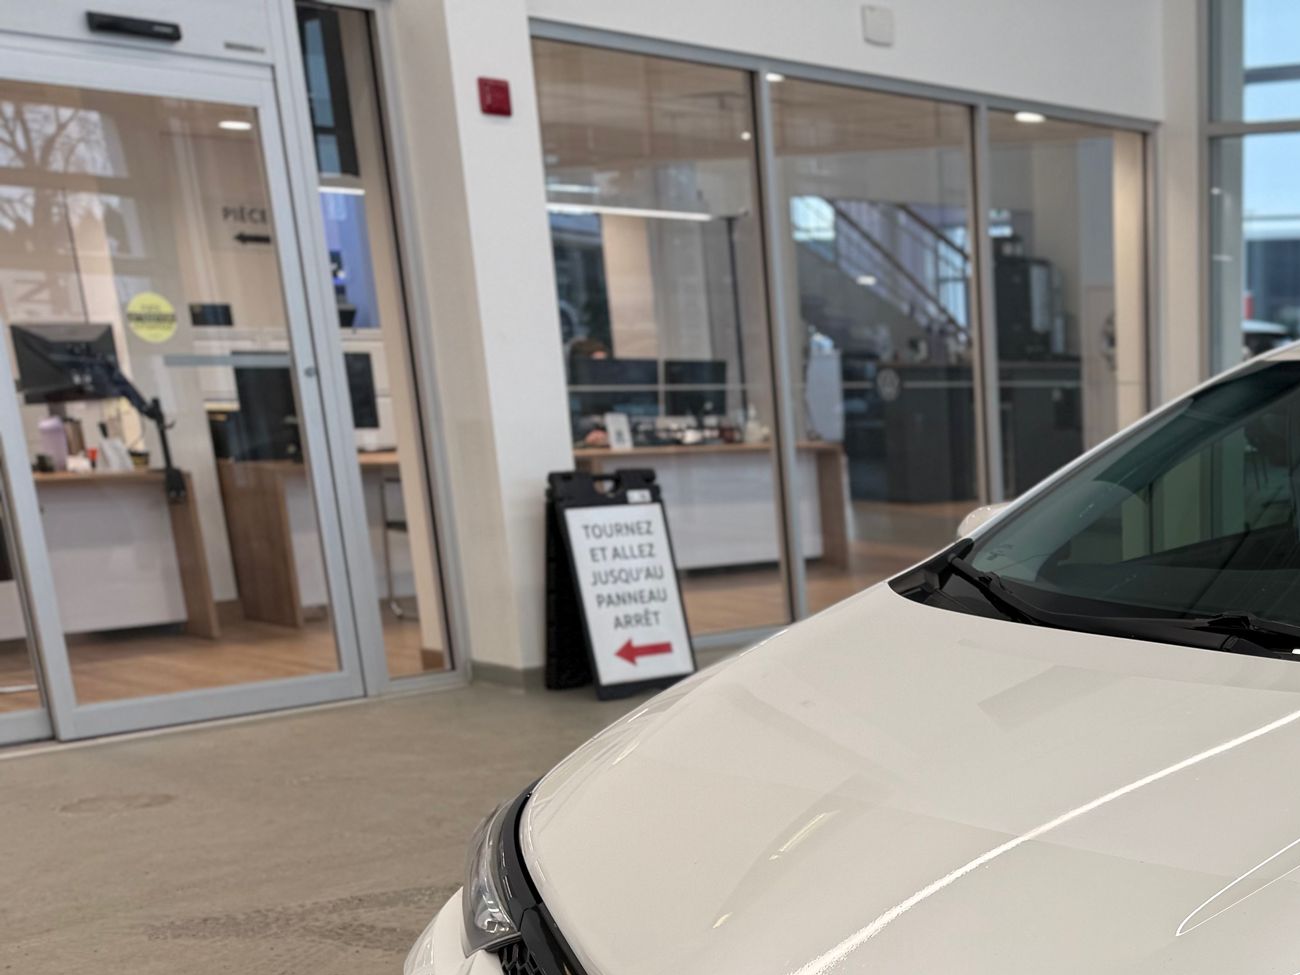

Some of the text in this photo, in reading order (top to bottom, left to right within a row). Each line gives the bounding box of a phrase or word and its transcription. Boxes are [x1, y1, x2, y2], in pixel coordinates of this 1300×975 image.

[582, 521, 653, 539] TOURNEZ
[589, 543, 655, 562] ET ALLEZ
[591, 566, 665, 586] JUSQU'AU
[596, 588, 668, 608] PANNEAU
[614, 610, 661, 630] ARRÊT
